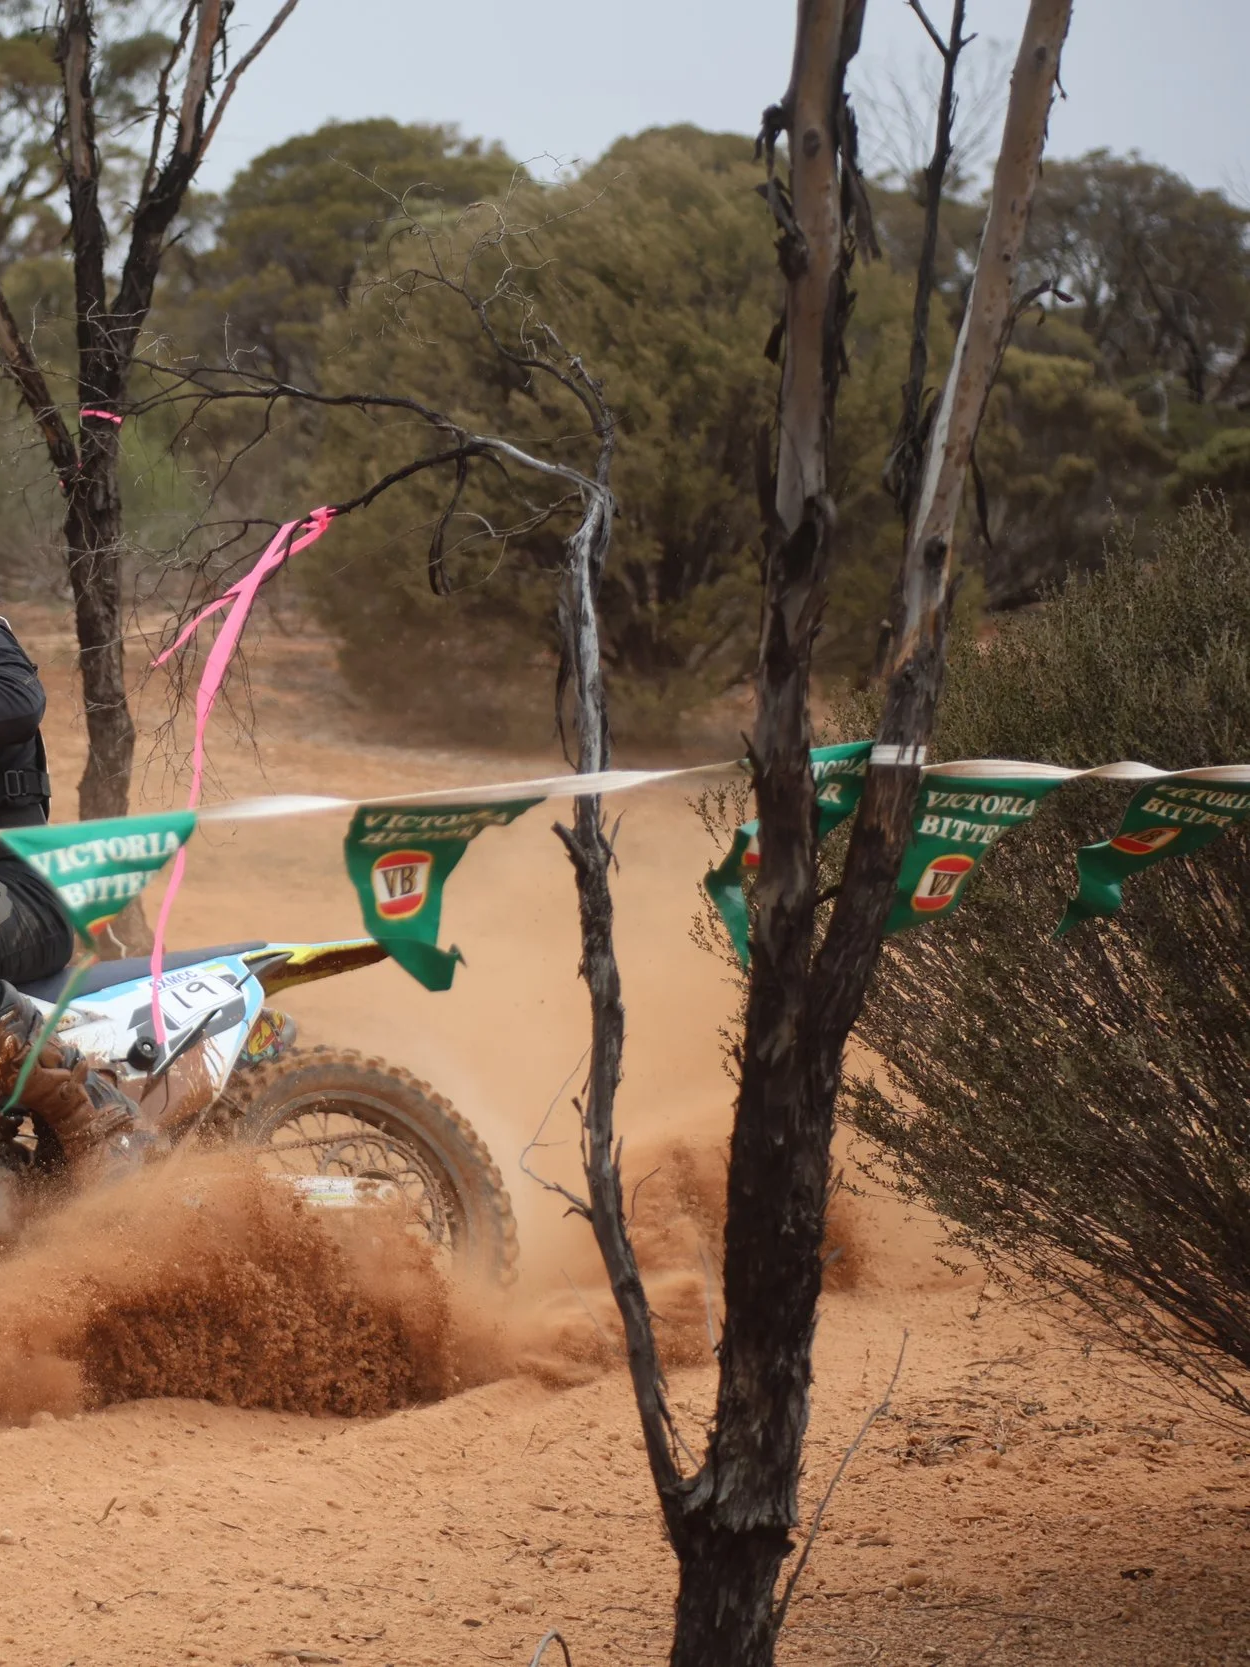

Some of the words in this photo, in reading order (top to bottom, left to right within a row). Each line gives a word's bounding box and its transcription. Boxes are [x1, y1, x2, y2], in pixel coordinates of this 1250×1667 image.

[926, 790, 1036, 816] VICTORIA
[1155, 784, 1250, 809] CTORI
[364, 809, 508, 829] VICTOA
[917, 814, 1007, 844] BITTE
[29, 831, 181, 876] VICTORIA
[58, 870, 152, 909] BITTE
[382, 865, 417, 898] VB
[170, 981, 218, 1008] 19
